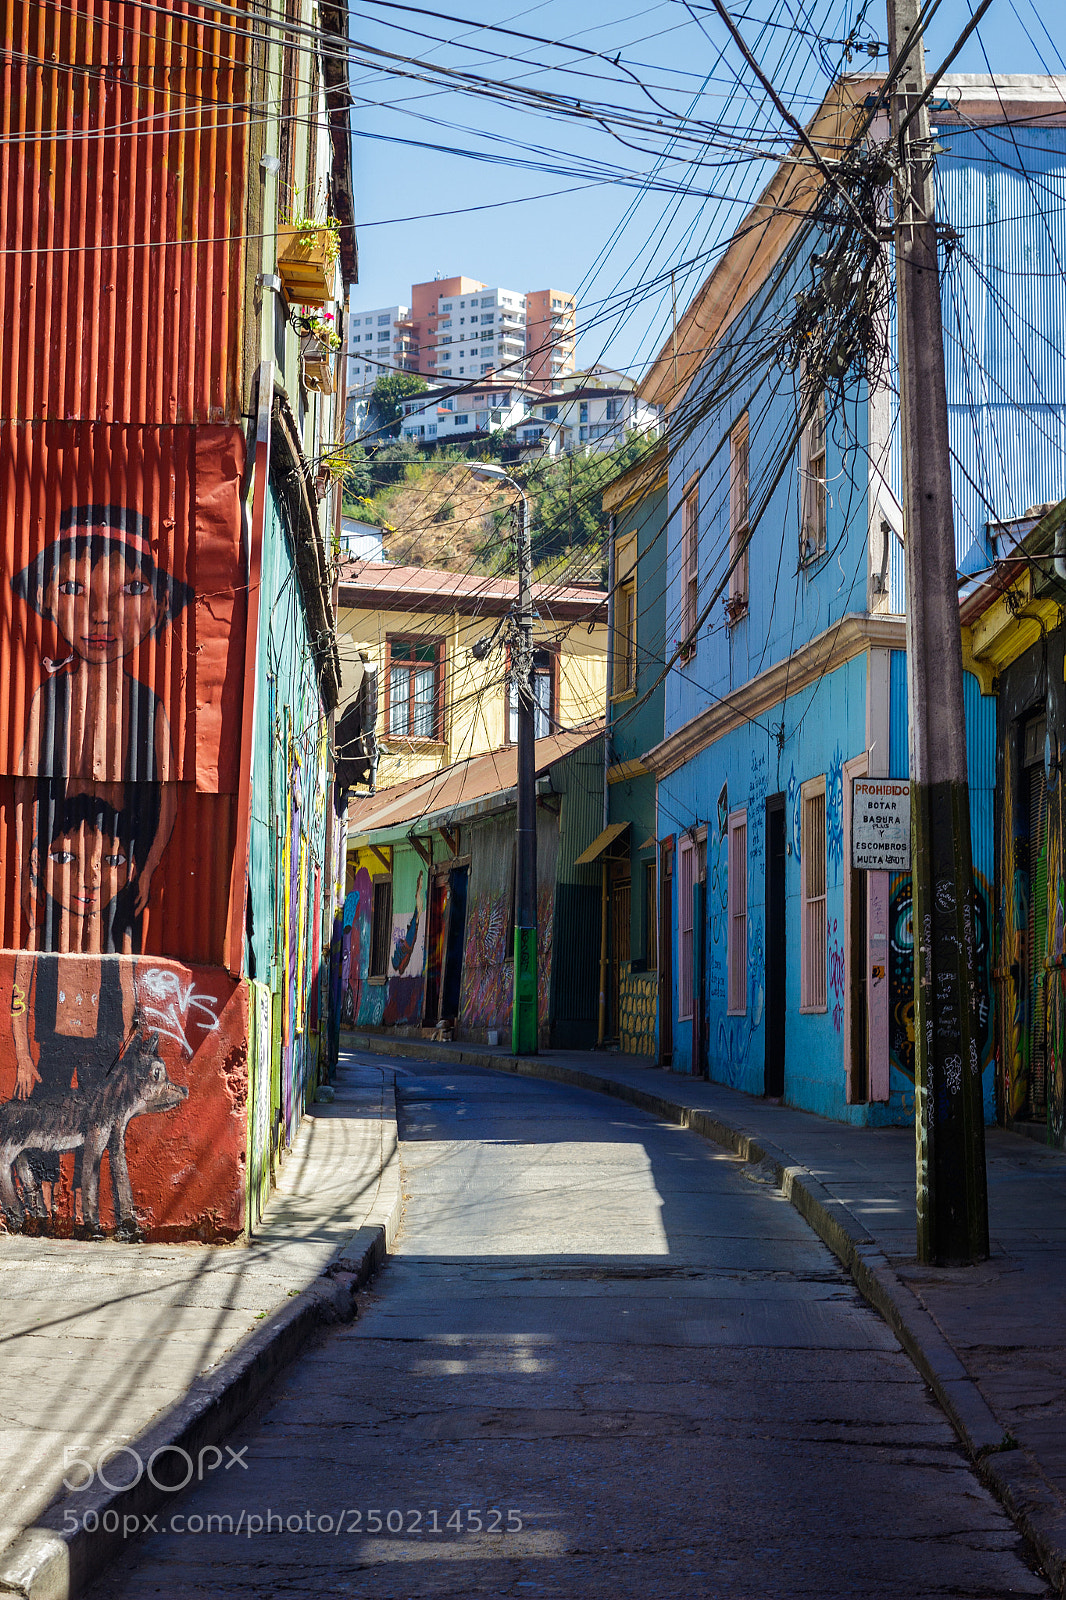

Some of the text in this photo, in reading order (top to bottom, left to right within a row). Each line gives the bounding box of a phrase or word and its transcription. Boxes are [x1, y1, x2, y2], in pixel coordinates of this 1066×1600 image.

[855, 784, 910, 796] PROHIBIDO
[867, 802, 897, 810] BOTAR
[863, 815, 901, 825] BASURA
[879, 830, 885, 838] Y
[856, 842, 907, 851] ESCOMBROS
